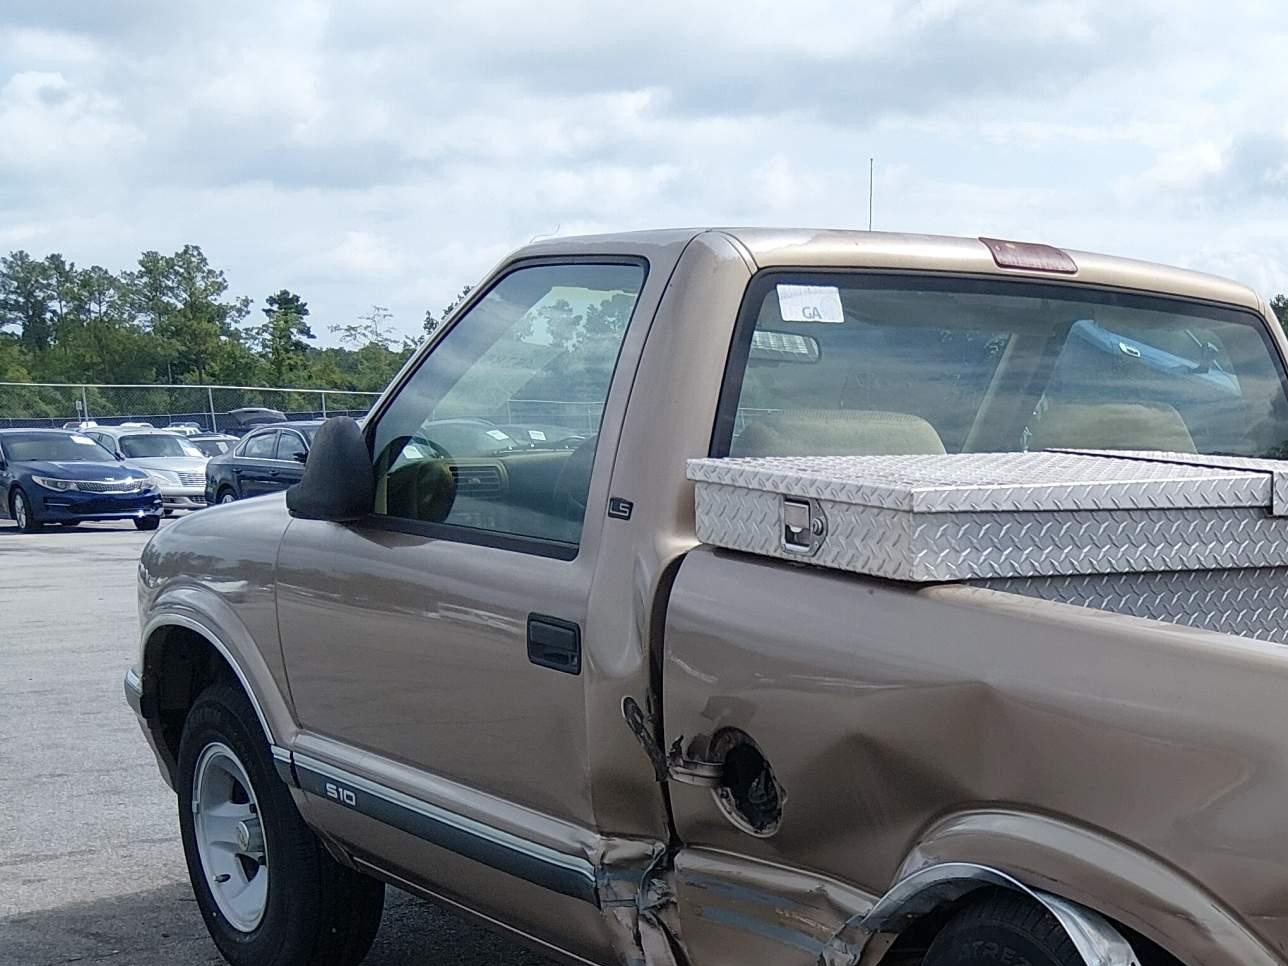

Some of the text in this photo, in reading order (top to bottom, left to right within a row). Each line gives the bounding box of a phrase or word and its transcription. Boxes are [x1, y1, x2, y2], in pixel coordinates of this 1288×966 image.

[802, 306, 822, 319] GA
[610, 500, 630, 516] LS
[326, 782, 356, 807] S10
